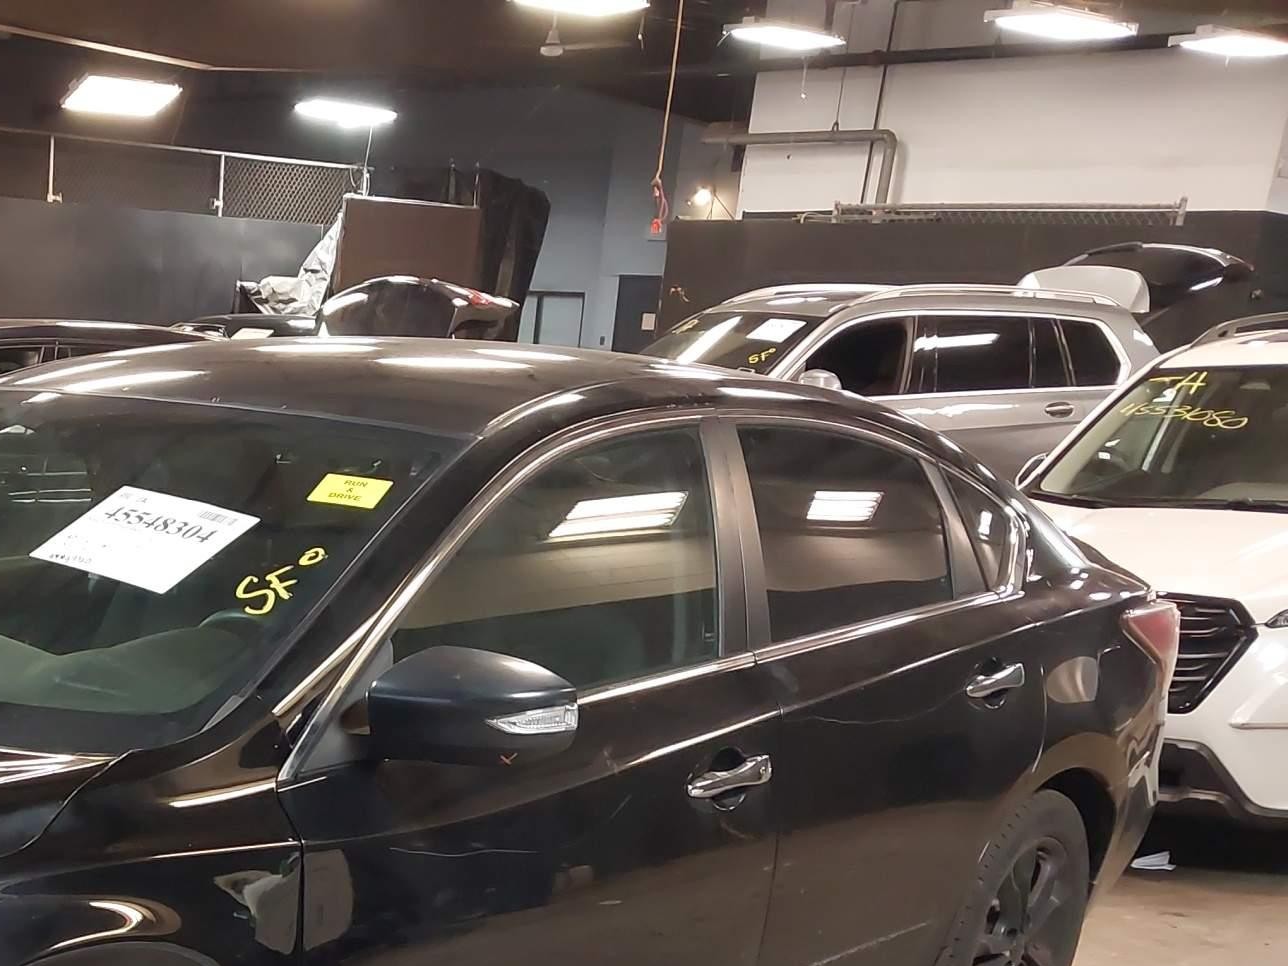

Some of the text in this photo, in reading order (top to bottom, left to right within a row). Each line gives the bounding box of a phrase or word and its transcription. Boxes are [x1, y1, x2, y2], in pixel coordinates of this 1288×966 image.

[343, 479, 368, 488] RUN
[328, 492, 363, 501] DRIVE
[103, 506, 218, 544] 45548304
